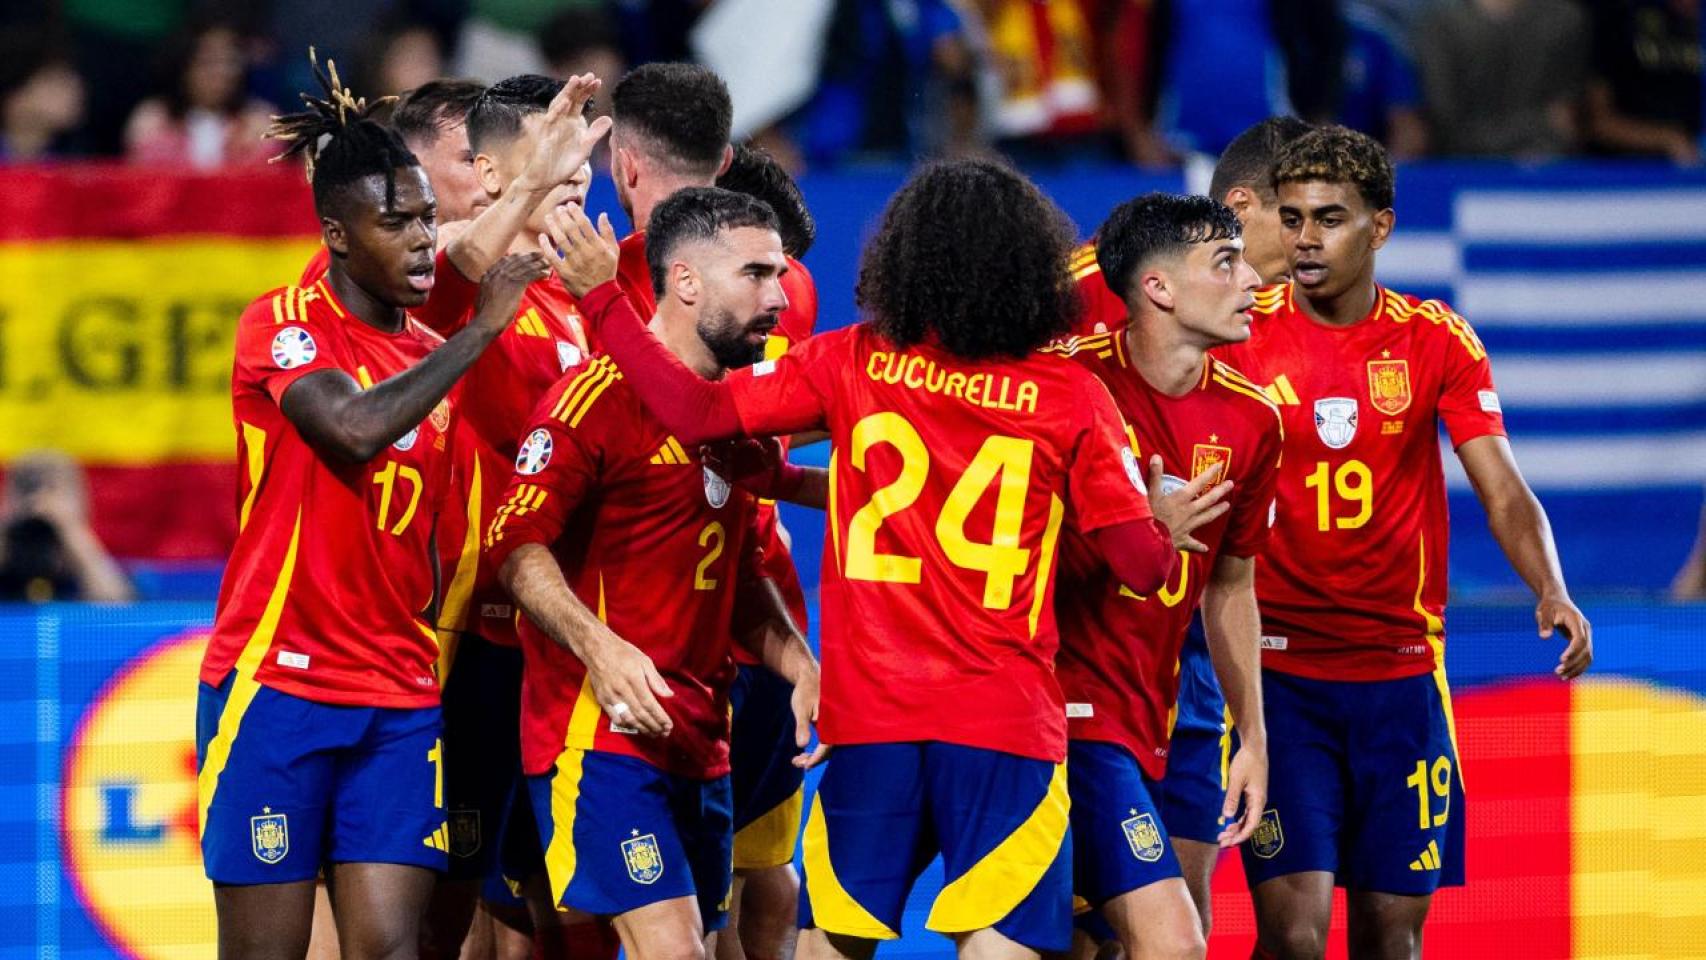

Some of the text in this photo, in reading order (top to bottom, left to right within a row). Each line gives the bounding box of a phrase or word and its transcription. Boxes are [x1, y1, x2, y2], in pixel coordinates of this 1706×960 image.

[866, 351, 1039, 413] CUCURELLA
[373, 460, 423, 535] 17
[845, 411, 1034, 609] 24
[1305, 459, 1373, 531] 19
[694, 521, 725, 590] 2
[1406, 755, 1451, 829] 19
